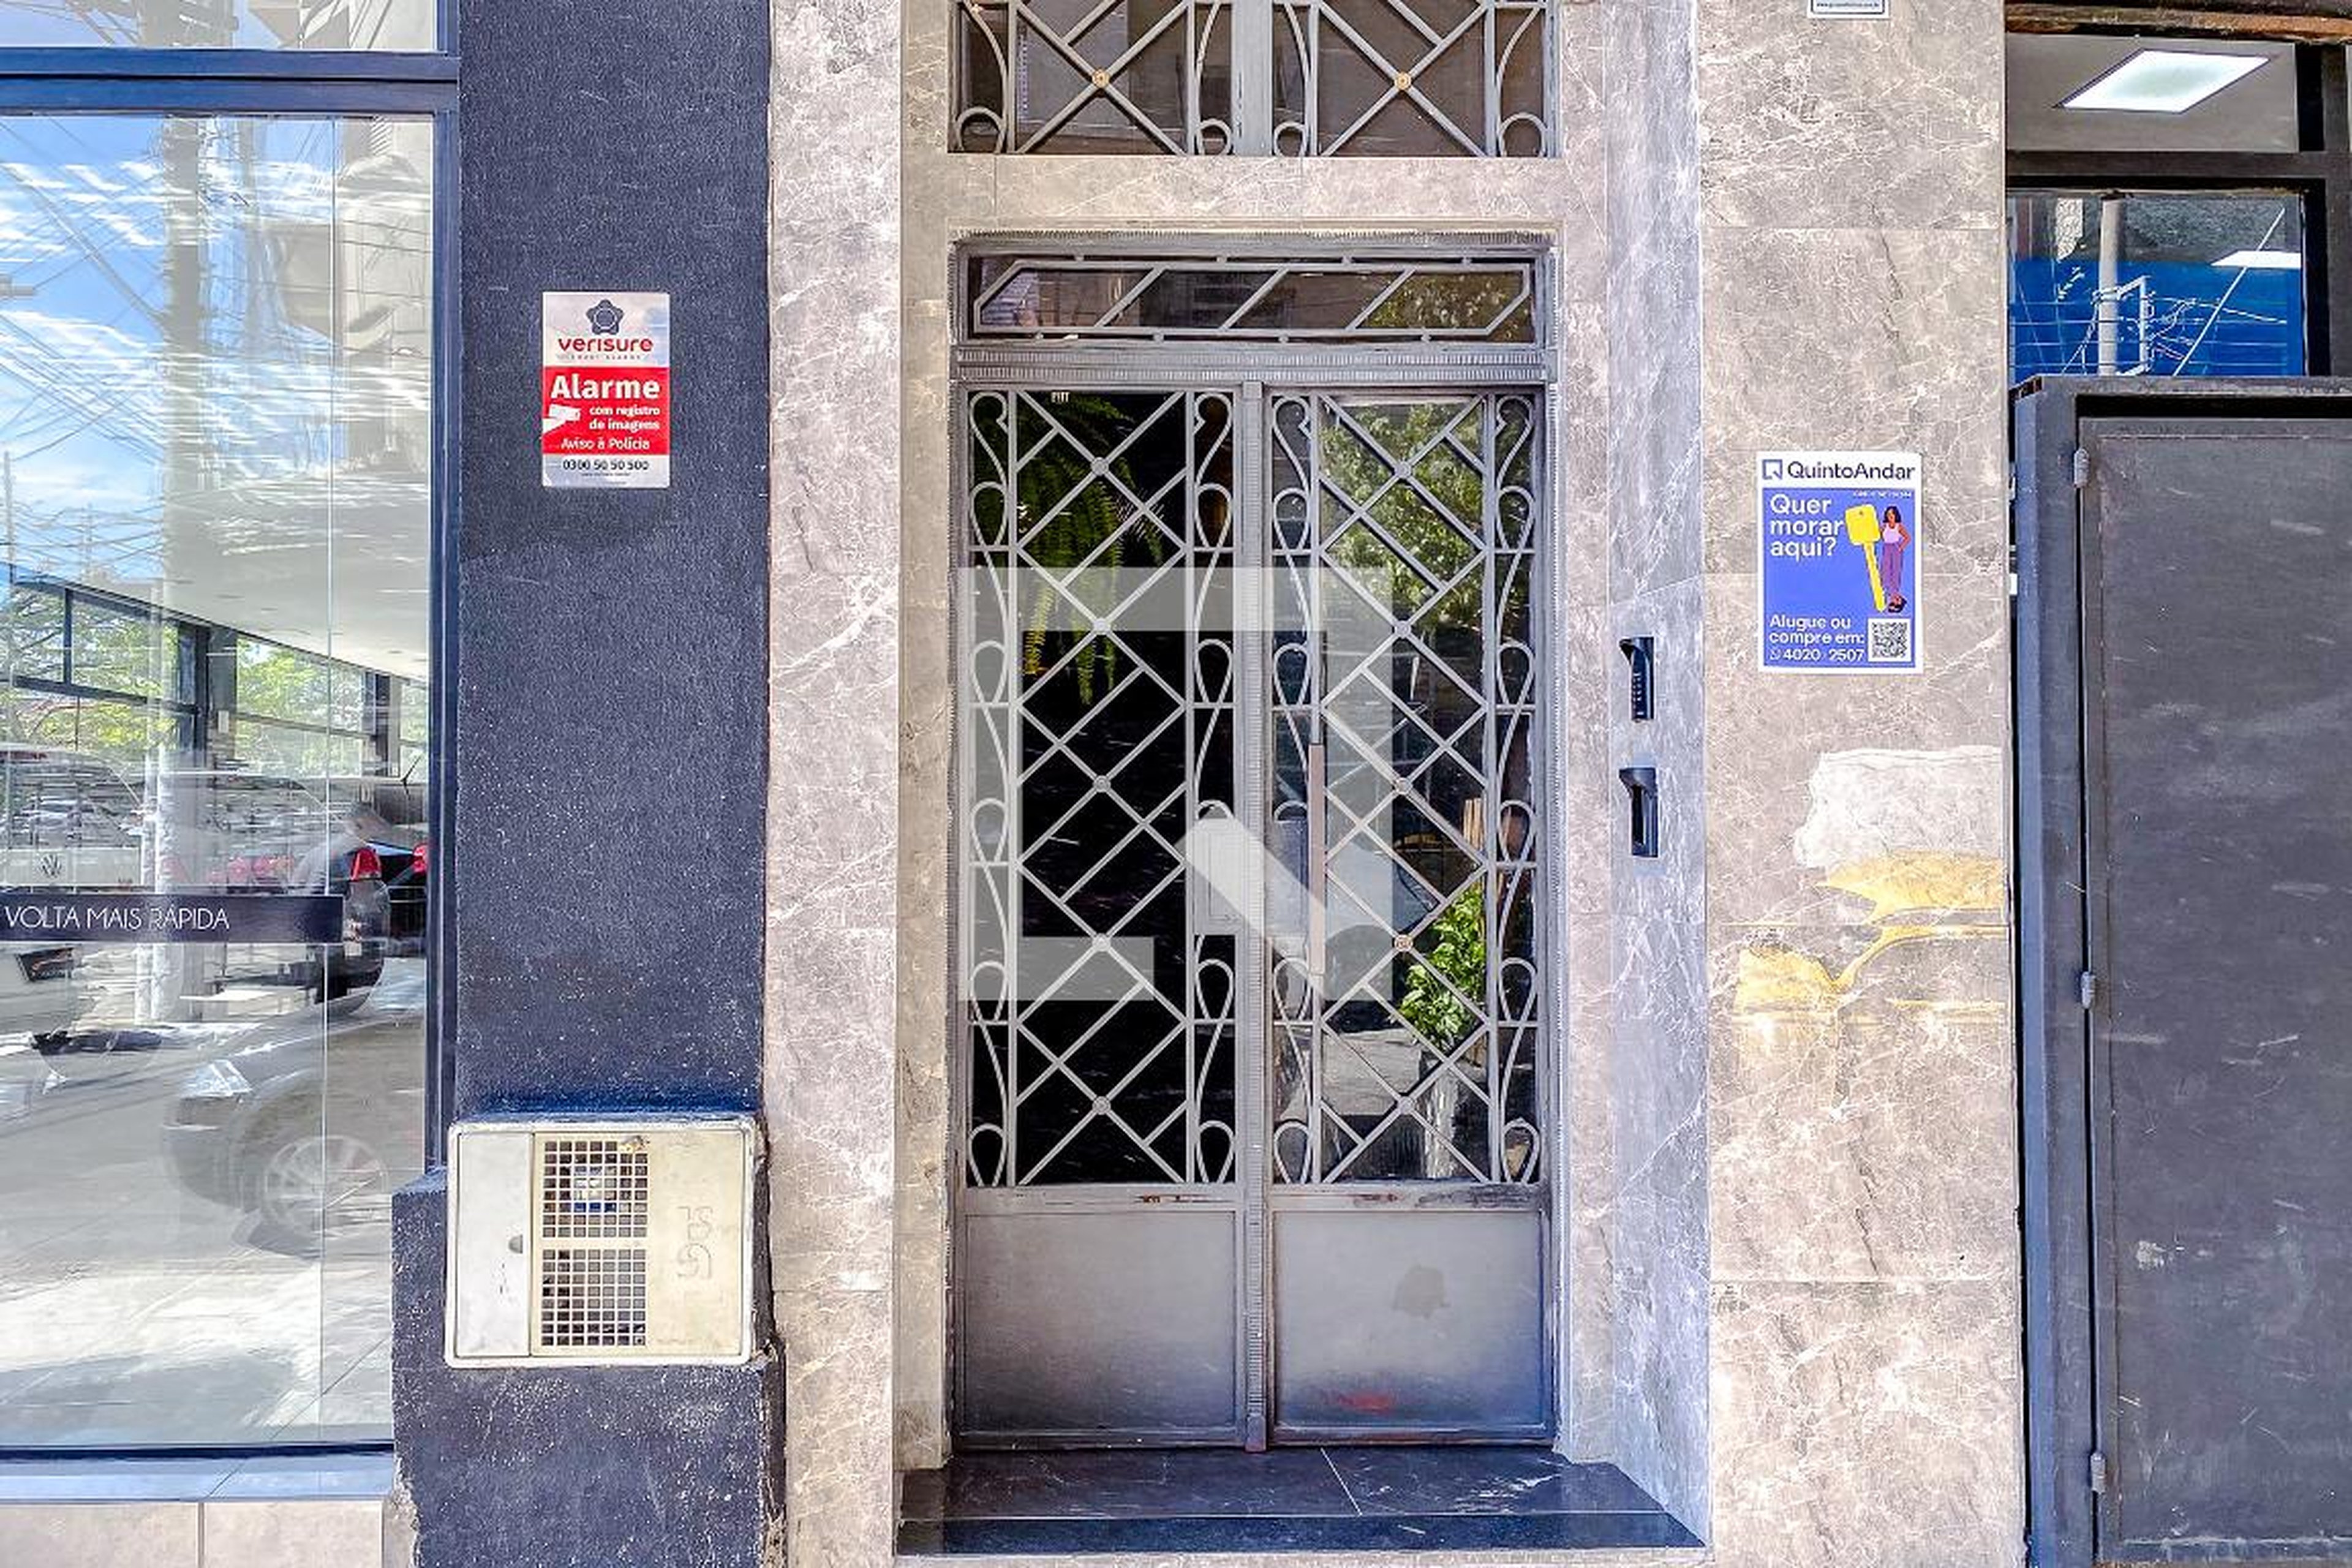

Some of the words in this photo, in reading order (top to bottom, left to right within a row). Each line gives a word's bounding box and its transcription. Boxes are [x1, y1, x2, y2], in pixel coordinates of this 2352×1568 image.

[559, 337, 654, 352] verisure
[551, 374, 660, 399] Alarme
[589, 407, 613, 415] com
[616, 405, 660, 418] registro
[589, 418, 605, 430] de
[608, 418, 660, 433] imagens
[560, 437, 594, 450] Aviso
[609, 437, 650, 450] Polícia
[563, 459, 590, 470] 0300
[594, 459, 608, 470] 50
[610, 459, 625, 470] 50
[627, 459, 650, 470] 500
[1787, 461, 1916, 480] QuintoAndar
[1770, 494, 1831, 516] Quer
[1770, 519, 1844, 536] morar
[1770, 538, 1836, 561] aqui?
[1769, 614, 1826, 631] Alugue
[1830, 617, 1851, 628] ou
[1769, 632, 1831, 647] compre
[1834, 633, 1865, 644] em:
[1783, 648, 1821, 661] 4020
[1828, 648, 1864, 662] 2507
[4, 905, 80, 929] VOLTA
[86, 905, 141, 930] MAIS
[149, 903, 231, 930] RÁPIDA
